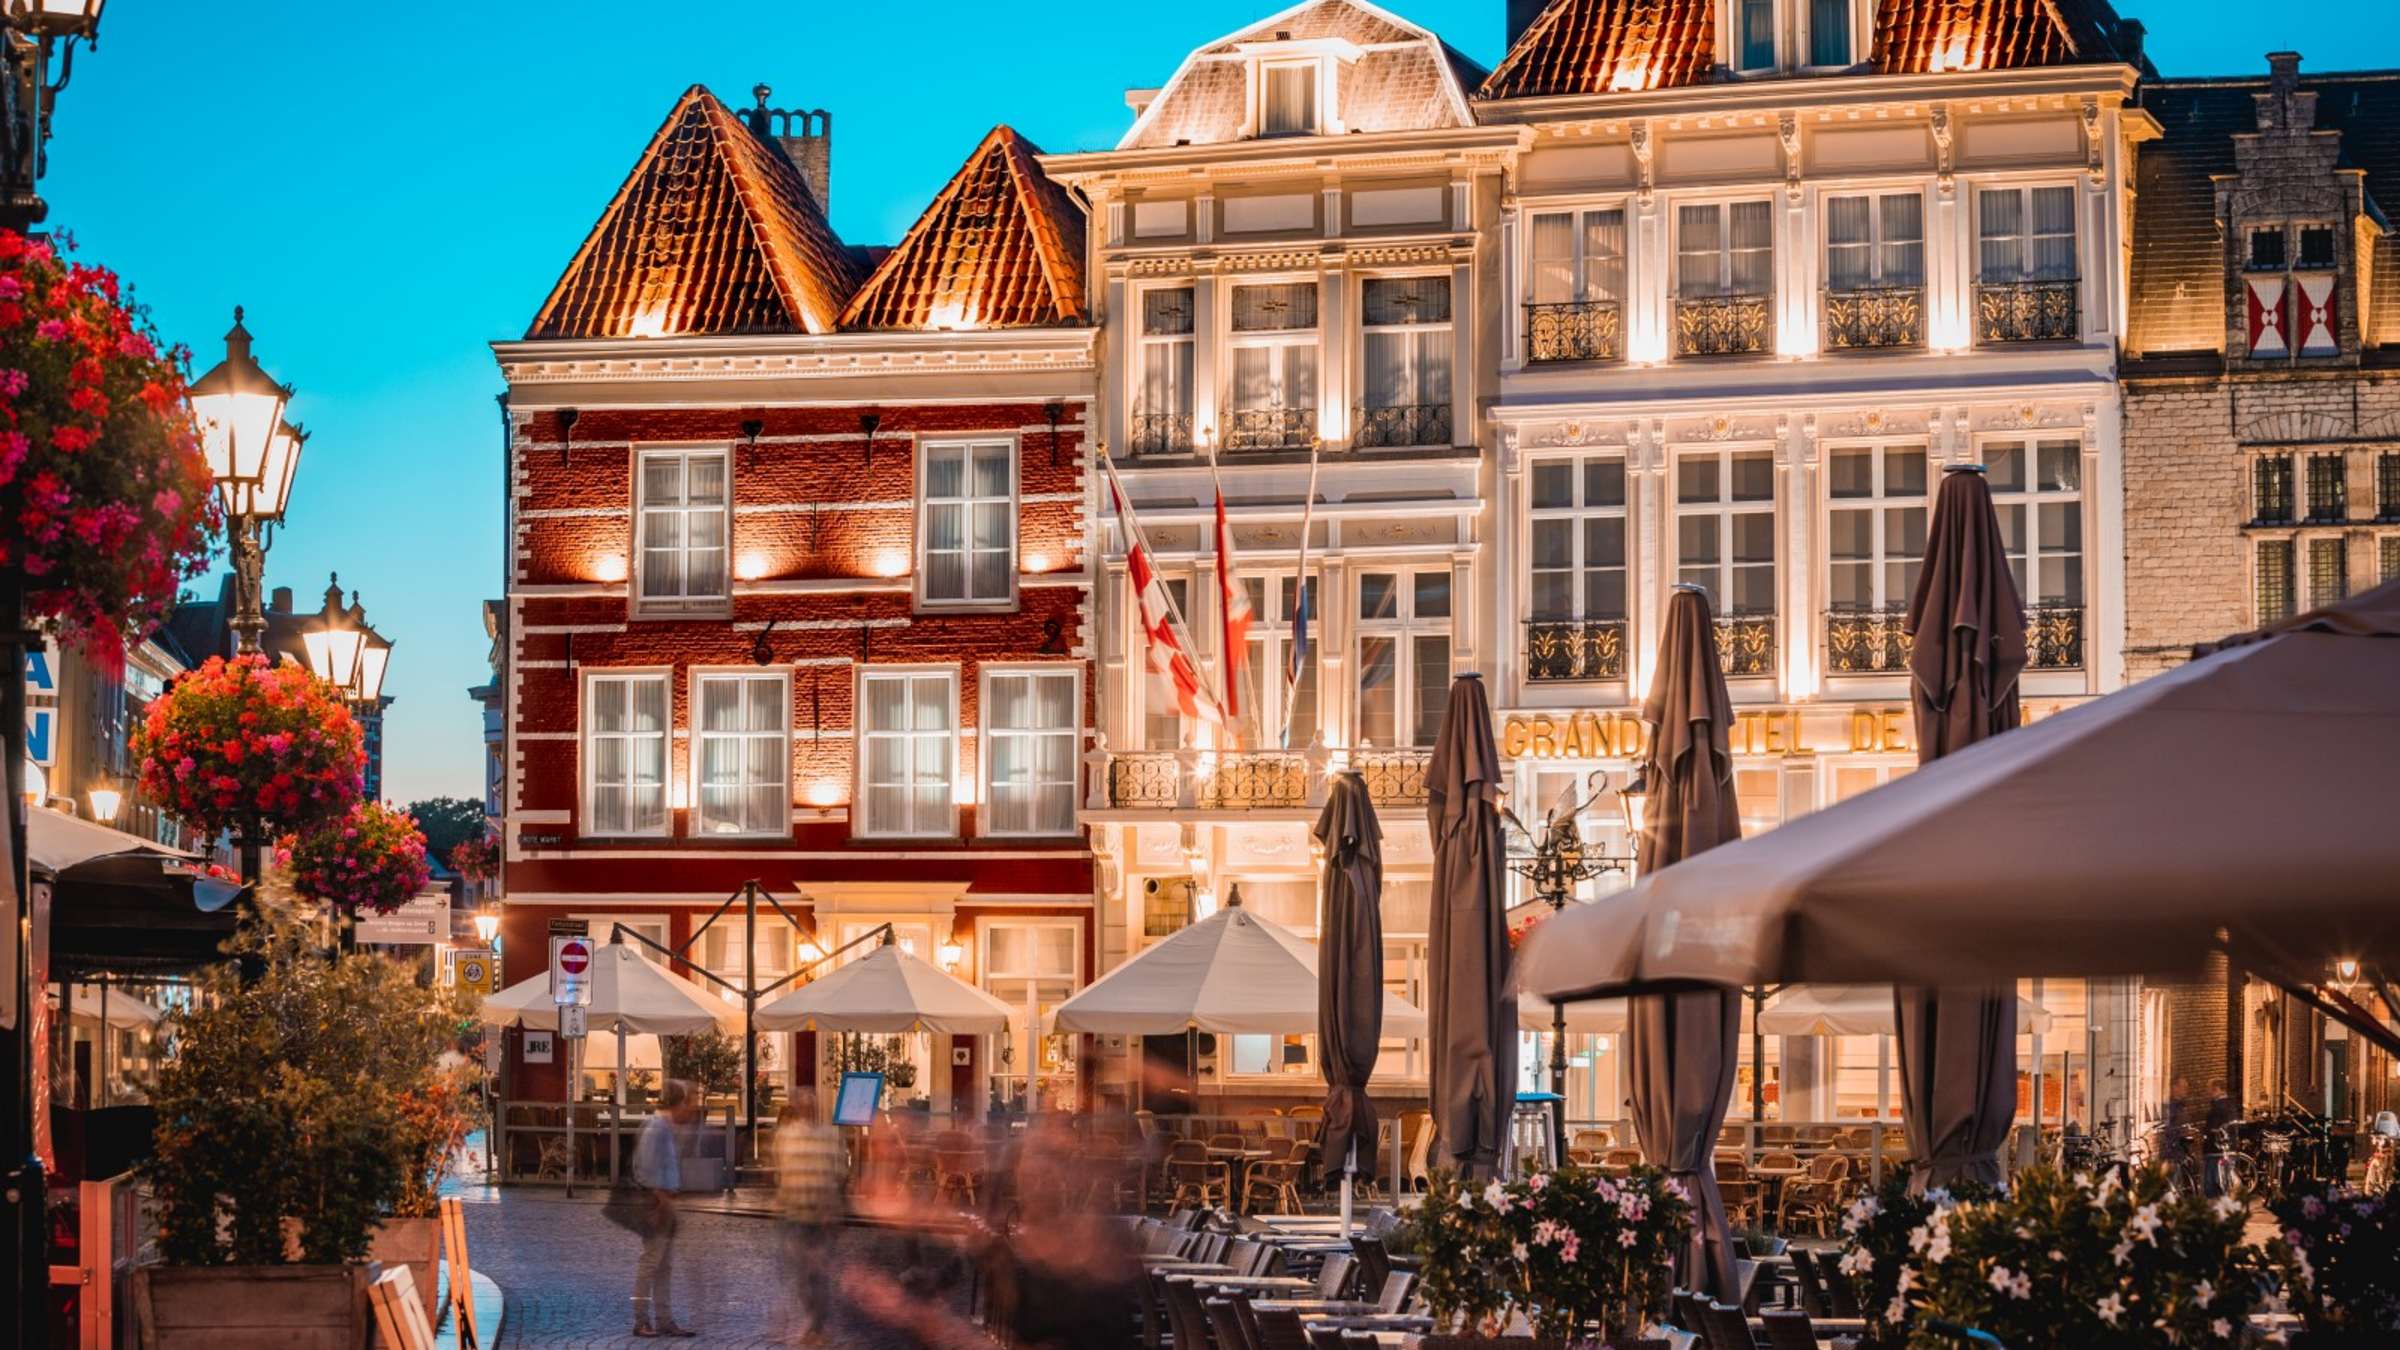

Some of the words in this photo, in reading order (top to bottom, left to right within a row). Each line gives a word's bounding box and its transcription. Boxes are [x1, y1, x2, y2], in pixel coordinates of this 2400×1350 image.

[1504, 711, 1645, 758] GRAND
[1850, 707, 1907, 752] DE
[526, 1039, 551, 1055] JRE
